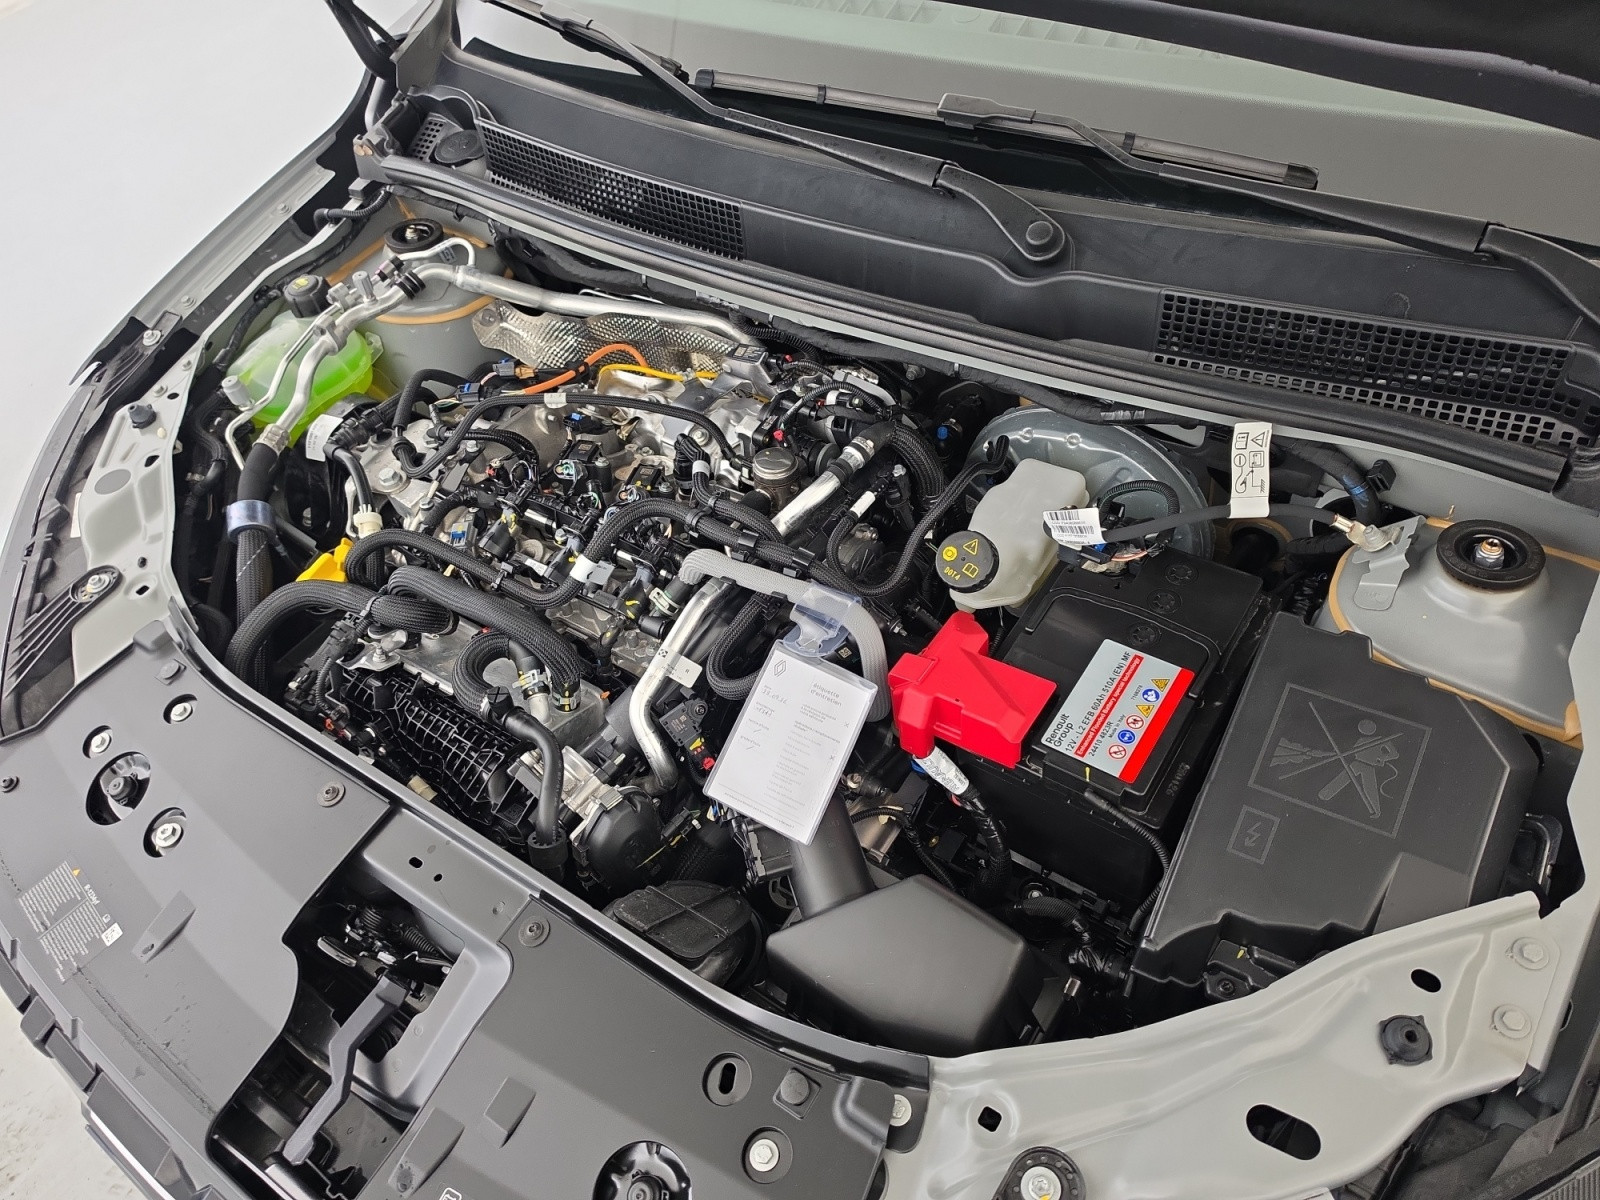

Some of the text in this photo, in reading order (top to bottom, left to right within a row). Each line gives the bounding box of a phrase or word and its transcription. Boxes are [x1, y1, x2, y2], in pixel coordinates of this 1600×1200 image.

[1065, 738, 1076, 751] 12V
[1076, 725, 1086, 735] L2
[1081, 711, 1094, 725] EFB
[1091, 694, 1106, 710] 60Ah
[1102, 677, 1116, 692] 510A
[1112, 662, 1126, 676] (EN)
[1121, 652, 1130, 661] MF
[1076, 658, 1140, 754] Enhanced Flooded Battery special technology
[1045, 714, 1069, 744] Renault
[1053, 722, 1073, 747] Group
[1088, 739, 1102, 756] 24410
